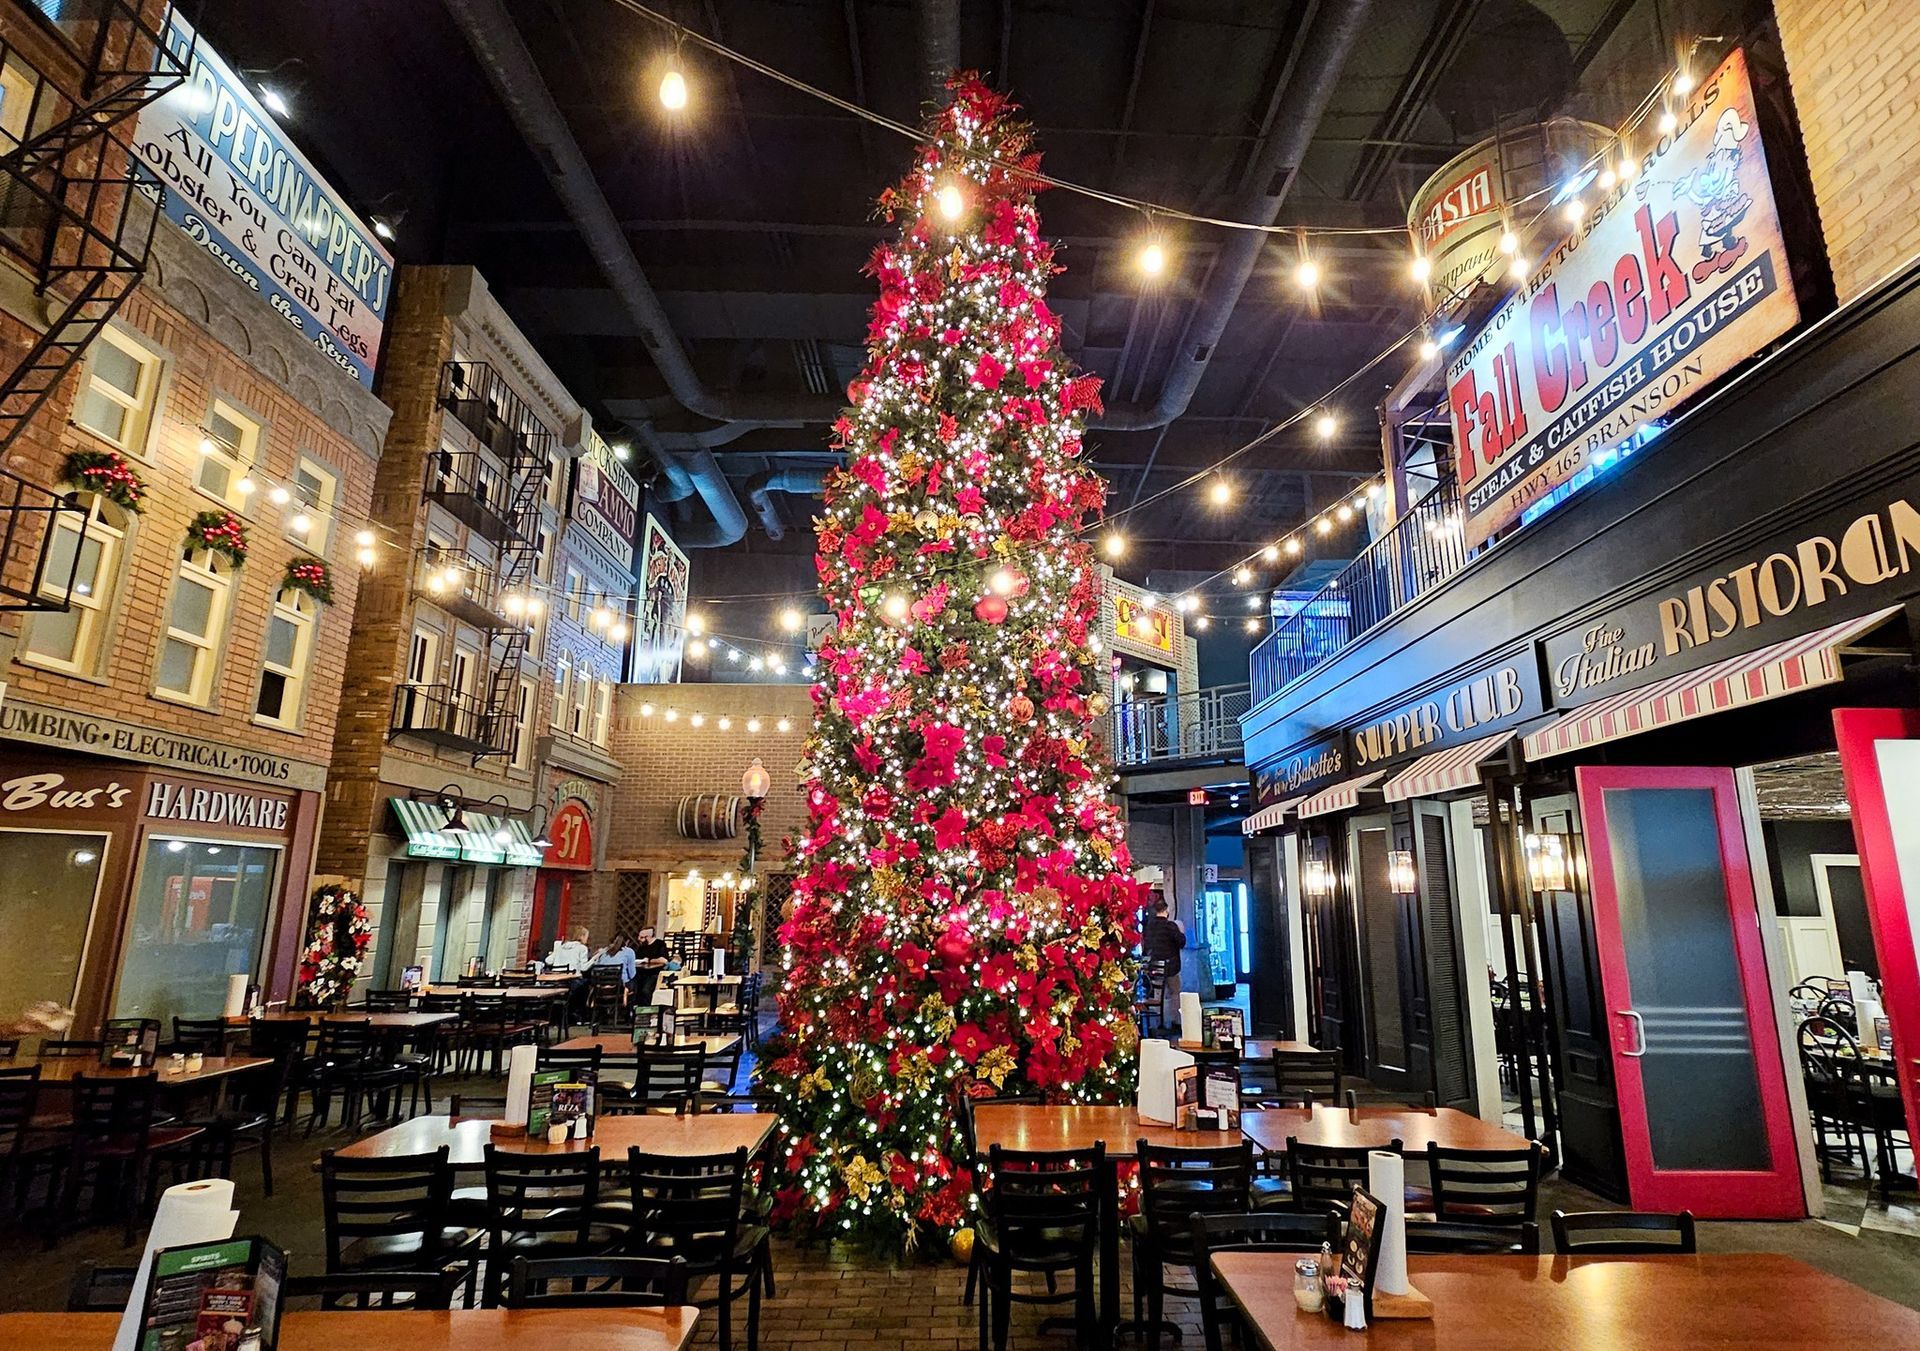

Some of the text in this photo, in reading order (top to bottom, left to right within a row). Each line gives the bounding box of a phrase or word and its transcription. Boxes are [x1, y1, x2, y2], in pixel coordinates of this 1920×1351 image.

[164, 121, 214, 179] All
[226, 171, 267, 233] You
[277, 227, 317, 286] Can
[325, 271, 355, 319] Eat
[180, 213, 360, 382] Down the Strip
[241, 229, 261, 259] &
[269, 257, 321, 315] Crab
[328, 306, 369, 360] Legs
[1495, 304, 1516, 333] OF
[1450, 203, 1691, 486] Fall Creek
[1467, 267, 1764, 514] STEAK & CATFISH HOUSE
[1510, 354, 1705, 511] HWY 165 BRANSON
[577, 501, 630, 564] COMPANY
[598, 479, 636, 540] AMMO
[1582, 622, 1626, 655] Fine
[1553, 641, 1659, 698] Italian
[1355, 666, 1524, 767] SUPPER CLUB
[112, 728, 231, 769] ELECTRICAL
[239, 754, 290, 780] TOOLS
[1287, 748, 1342, 791] Babette's
[0, 773, 133, 811] Bus's
[147, 781, 290, 831] HARDWARE
[557, 812, 584, 859] 37
